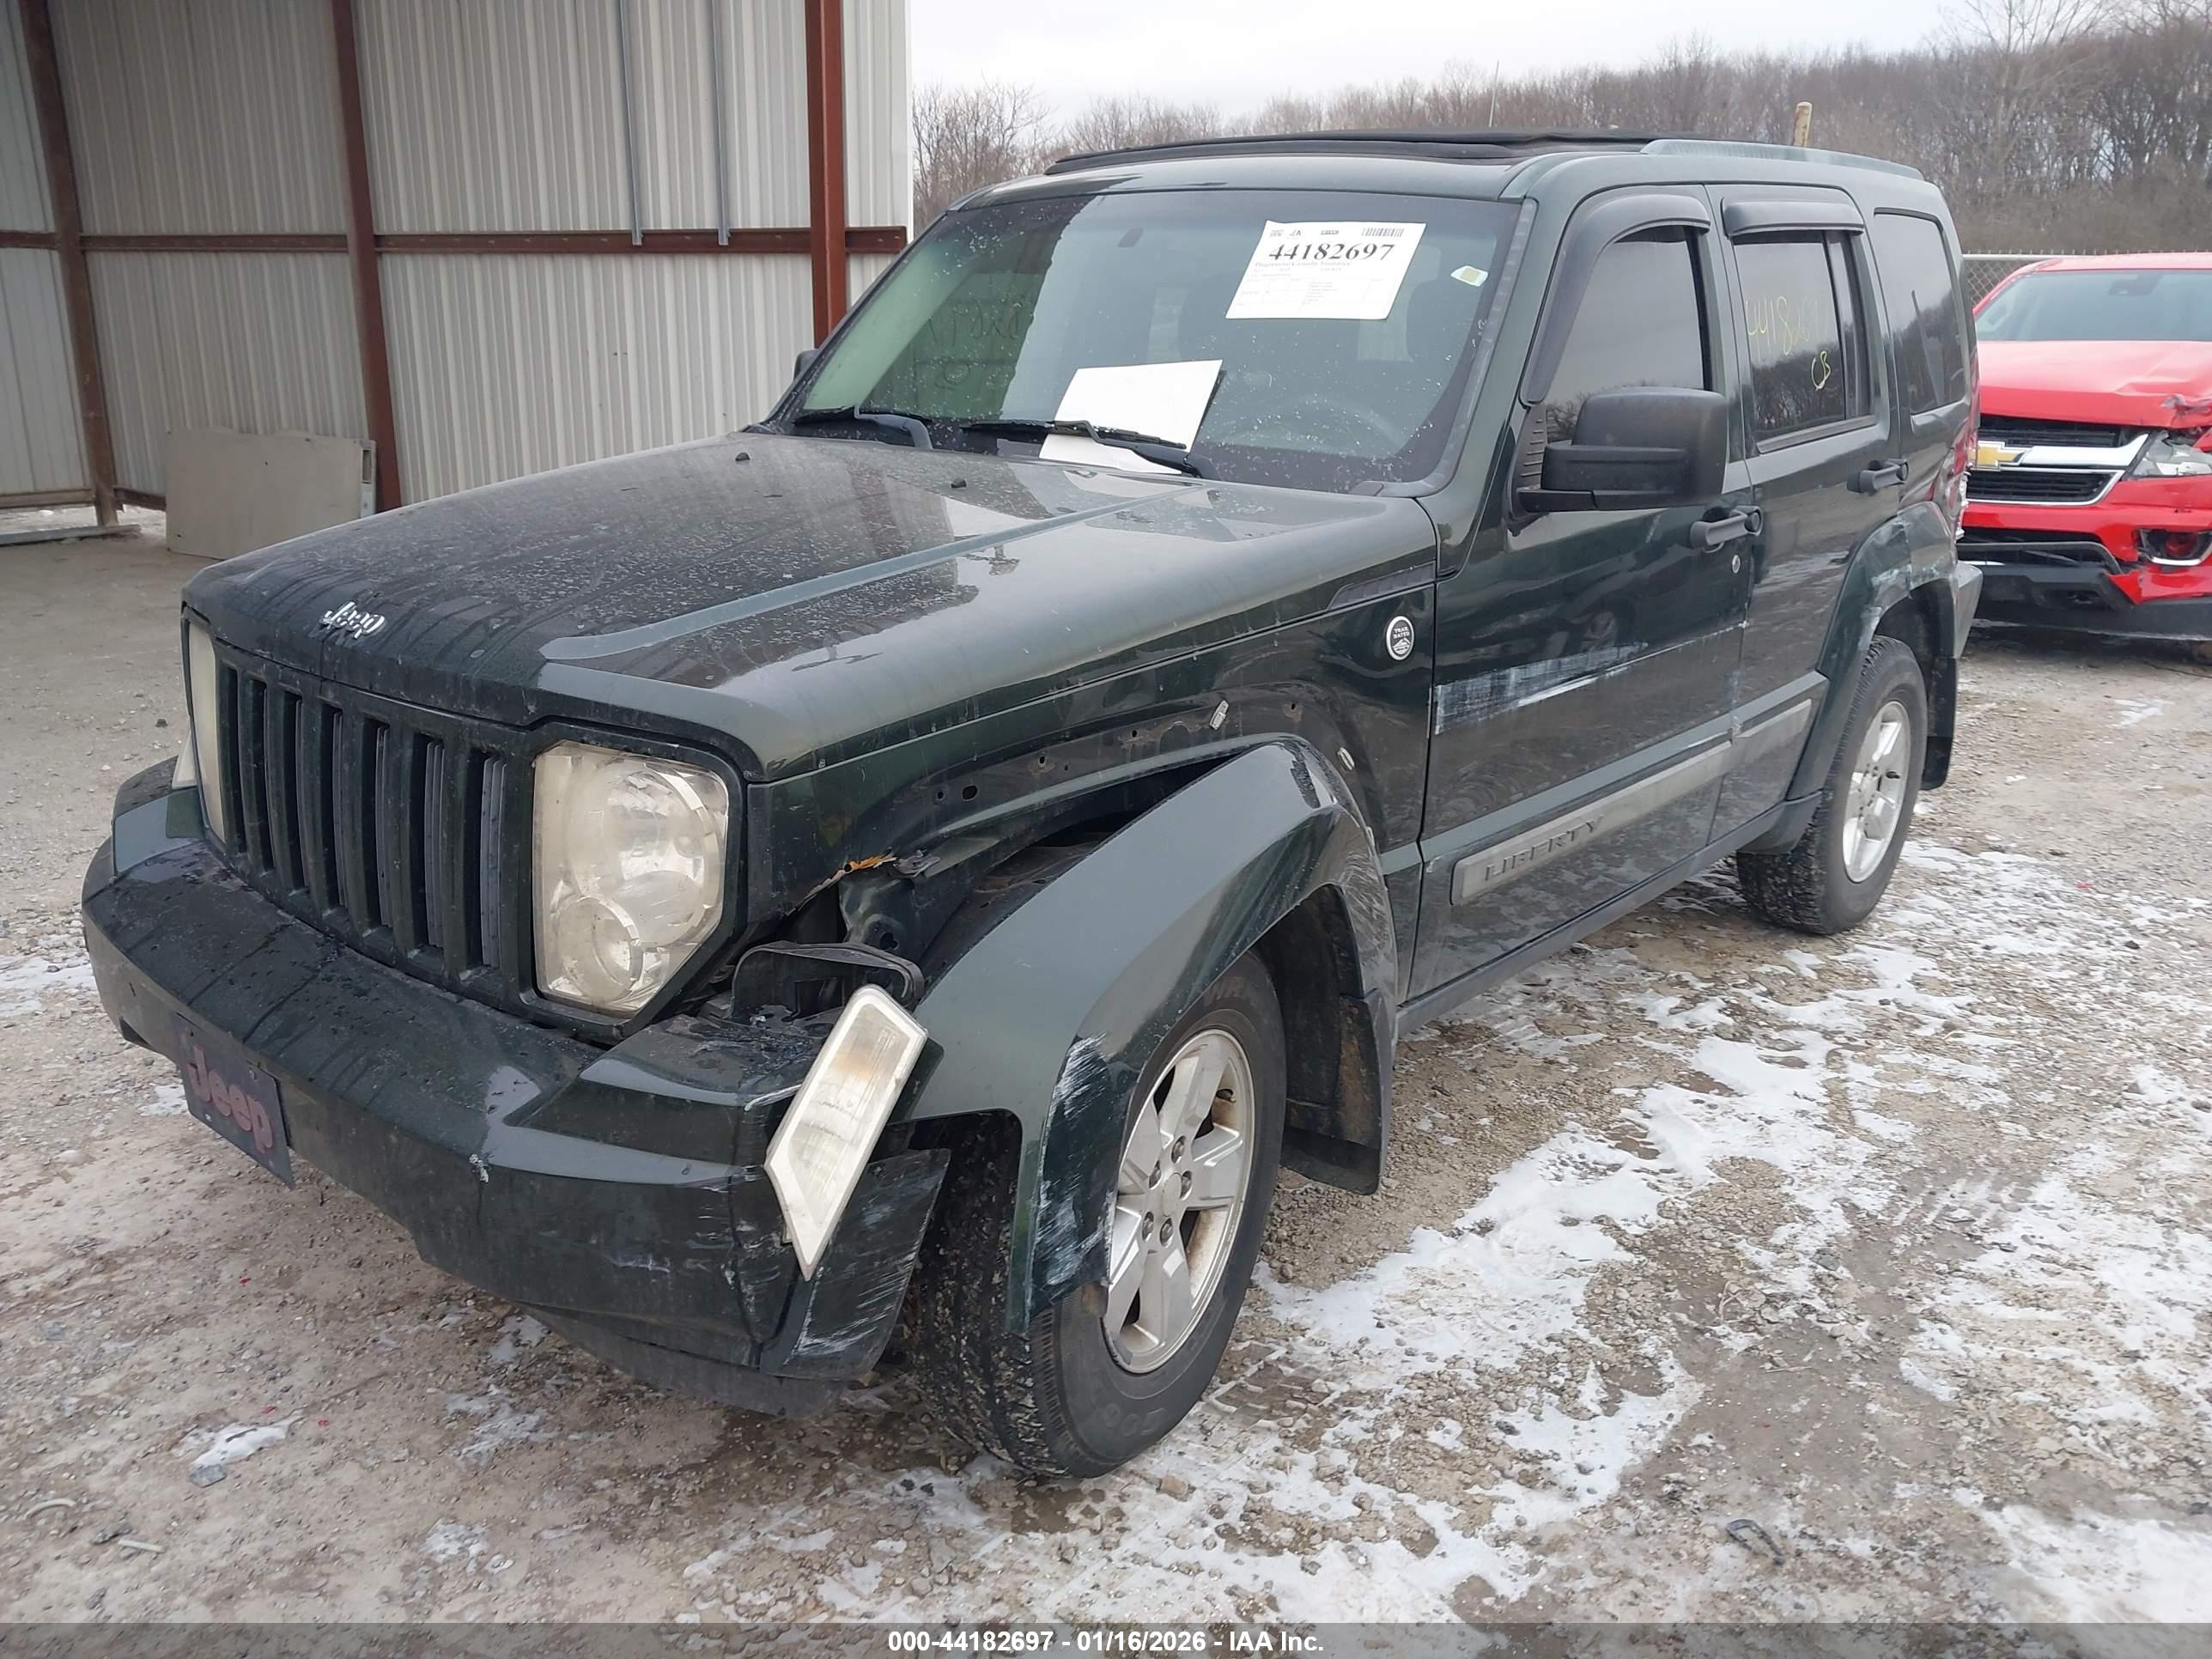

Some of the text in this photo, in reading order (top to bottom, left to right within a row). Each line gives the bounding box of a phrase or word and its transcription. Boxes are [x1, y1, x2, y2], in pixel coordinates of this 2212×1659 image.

[1269, 244, 1395, 260] 44182697
[321, 601, 386, 639] Jeep
[1486, 815, 1603, 881] LIBERTY
[186, 1044, 274, 1153] Jeep
